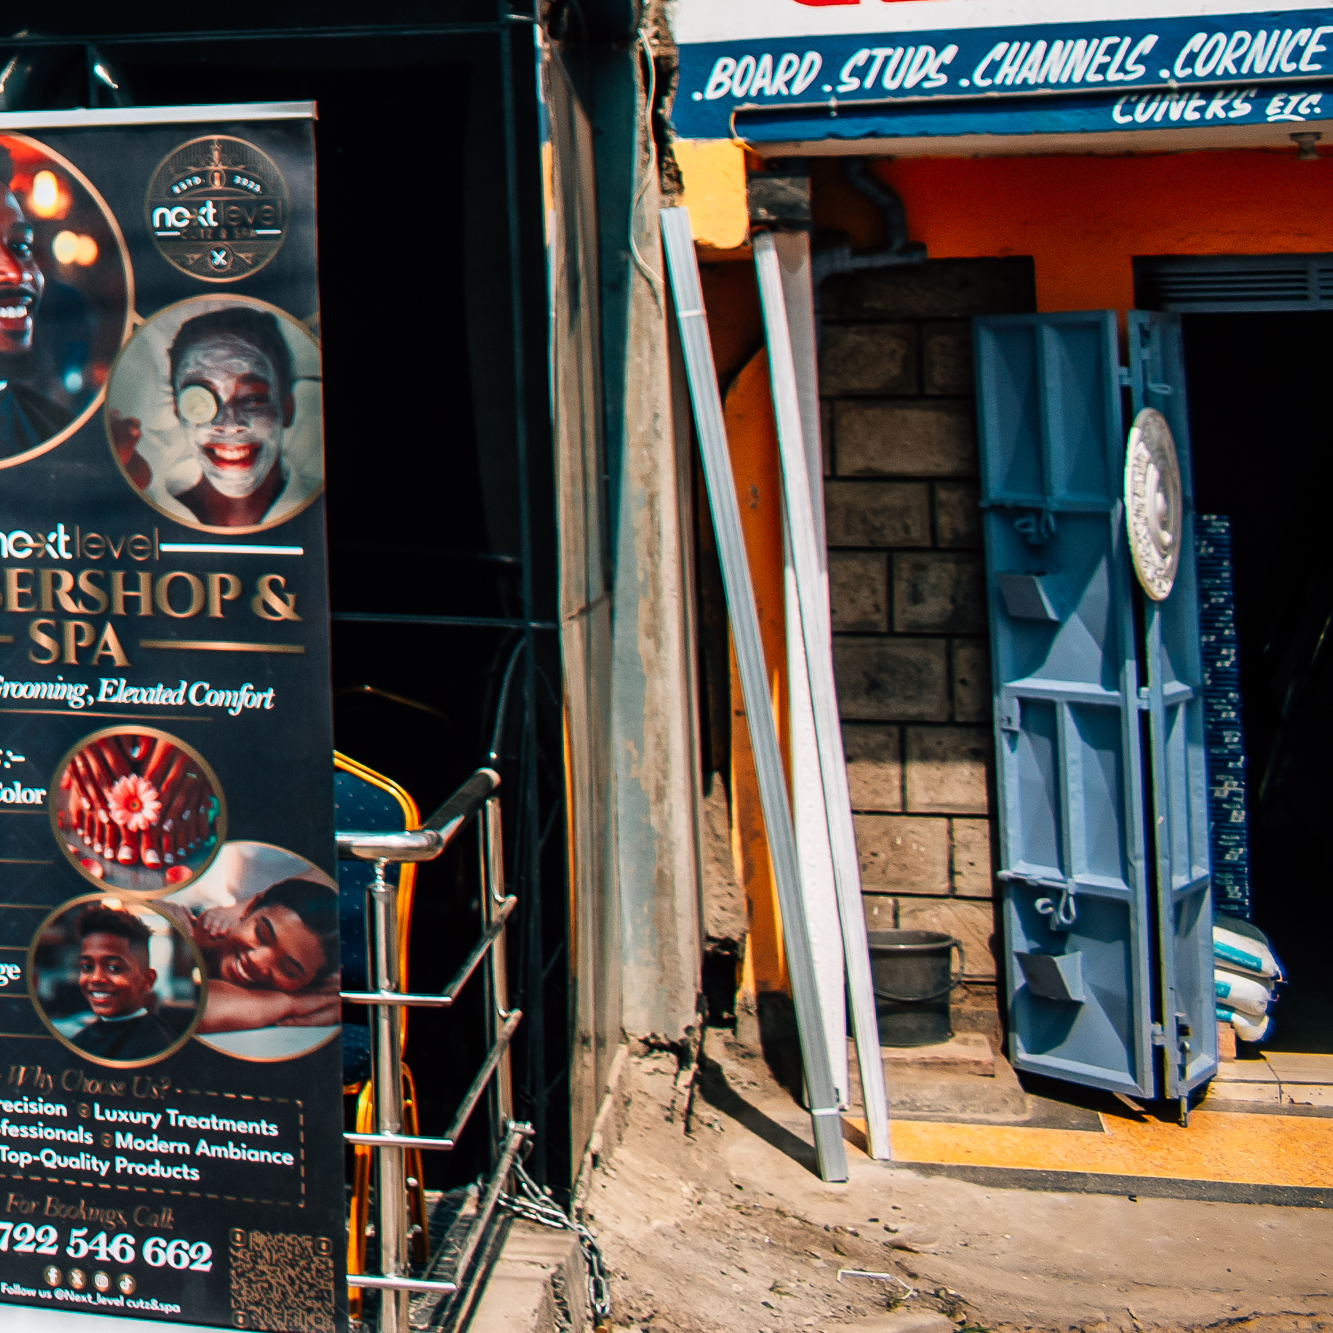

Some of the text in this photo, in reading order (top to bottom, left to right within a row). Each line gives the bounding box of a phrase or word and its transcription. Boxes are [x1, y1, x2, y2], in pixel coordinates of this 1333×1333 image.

[1265, 92, 1323, 115] ETC.
[153, 200, 282, 228] next level
[75, 526, 160, 561] level
[251, 573, 305, 621] &
[29, 619, 131, 667] SPA
[98, 678, 186, 706] Elevated
[188, 680, 275, 716] Comfort
[8, 1065, 171, 1100] Why Choose Us?
[93, 1102, 279, 1137] Luxury Treatments
[114, 1131, 295, 1166] Modern Ambiance
[115, 1156, 201, 1181] Products
[5, 1192, 41, 1215] For
[133, 1205, 175, 1230] Call
[65, 1226, 136, 1264] 546
[142, 1236, 213, 1273] 662
[0, 1282, 36, 1298] Follow
[38, 1287, 52, 1300] us
